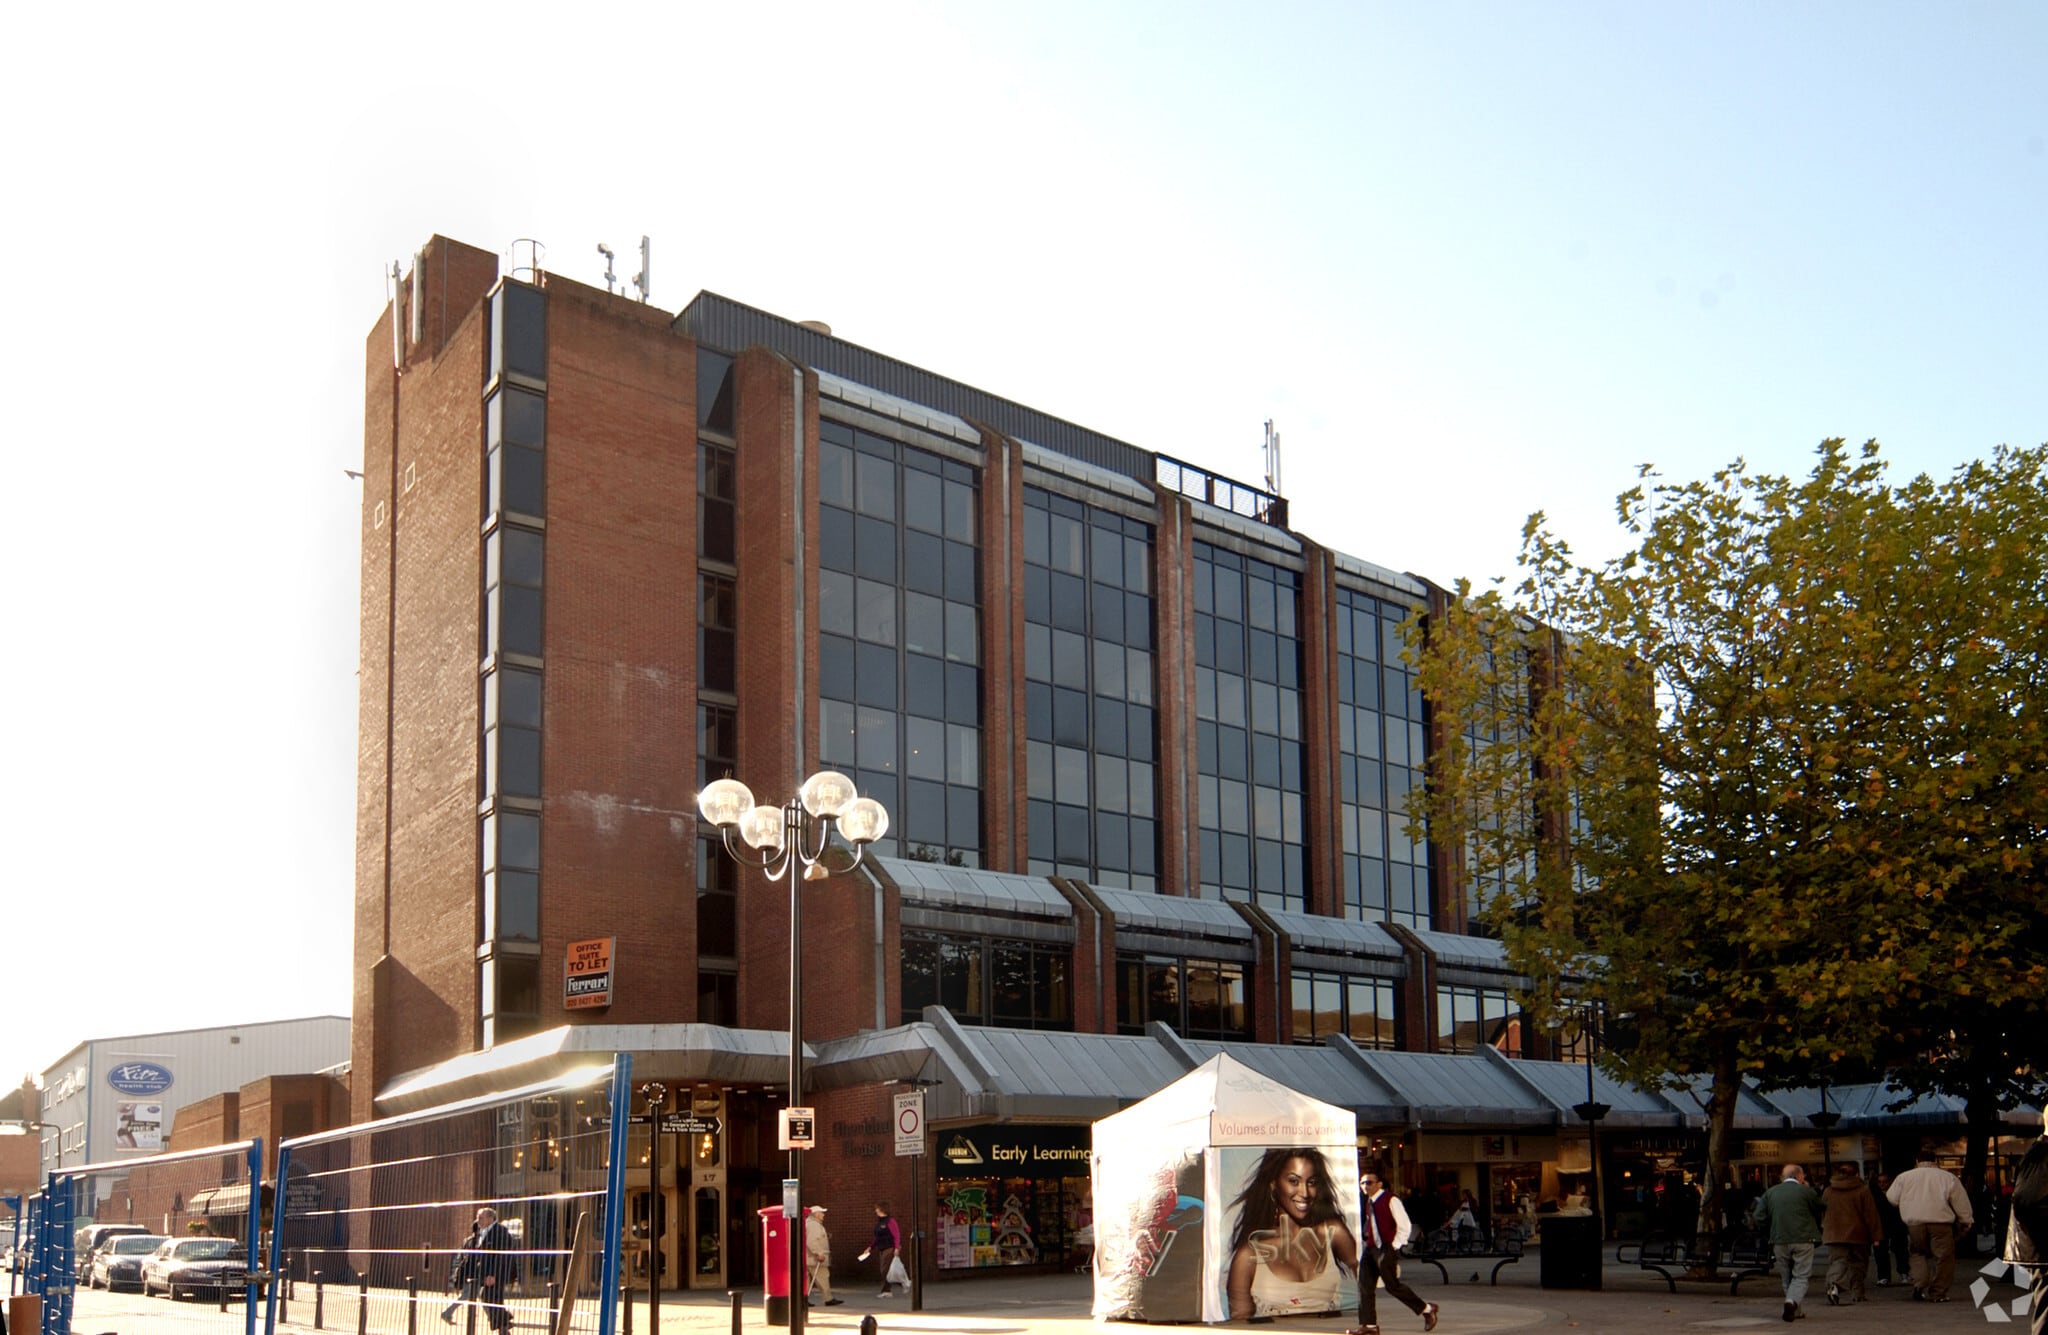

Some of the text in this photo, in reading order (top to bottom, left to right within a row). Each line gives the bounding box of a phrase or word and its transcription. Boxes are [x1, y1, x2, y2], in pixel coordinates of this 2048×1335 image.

[576, 943, 603, 952] OFFICE
[578, 952, 600, 961] SUITE
[569, 957, 608, 972] TO LET
[567, 975, 608, 993] Ferrari
[899, 1100, 917, 1108] ZONE
[1219, 1123, 1265, 1136] Volumes
[1269, 1122, 1280, 1135] of
[1281, 1124, 1312, 1136] music
[992, 1145, 1092, 1165] Early Learning
[704, 1173, 716, 1182] 17
[1248, 1213, 1337, 1274] sky
